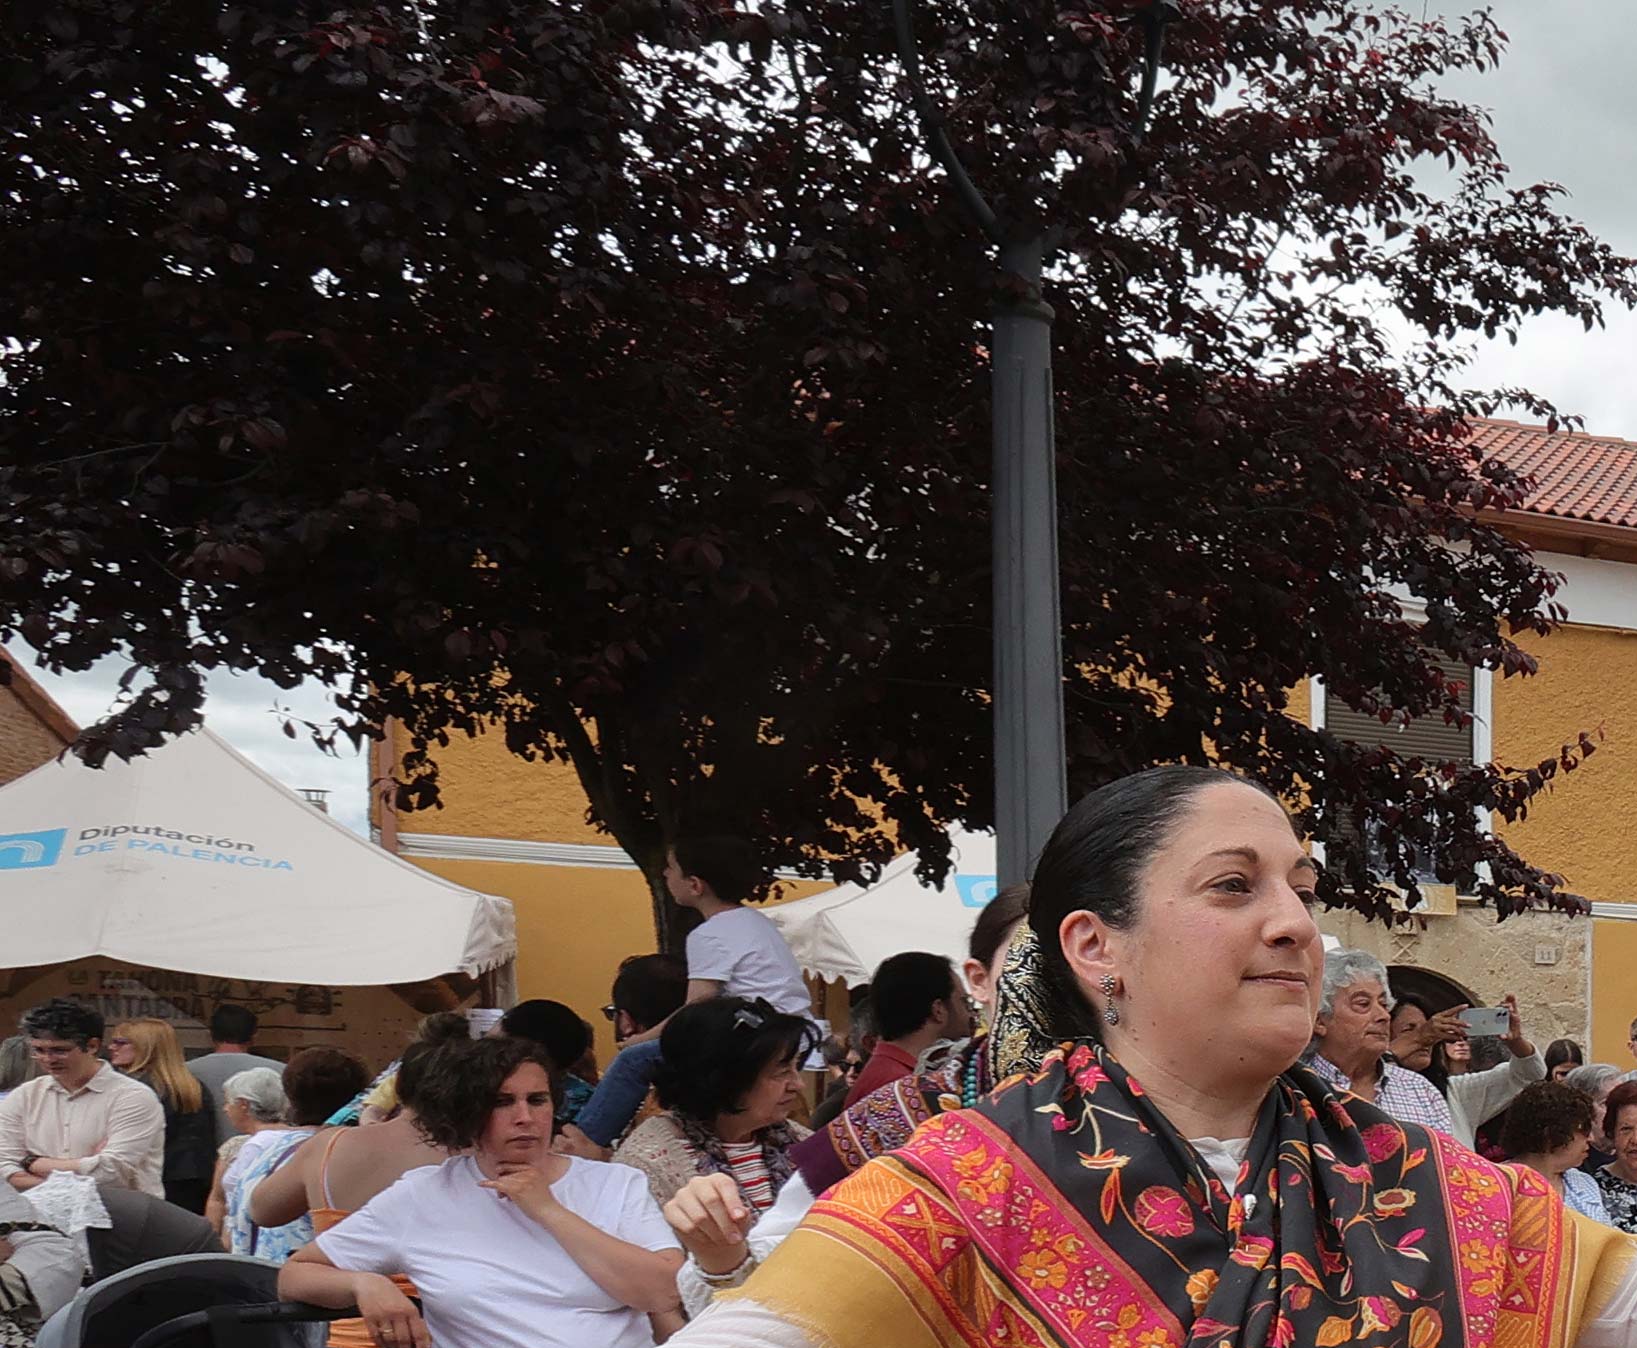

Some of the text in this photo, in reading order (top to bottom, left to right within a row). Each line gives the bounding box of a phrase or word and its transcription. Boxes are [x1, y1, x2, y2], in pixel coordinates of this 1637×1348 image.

[77, 825, 257, 853] Diputación
[73, 838, 294, 872] DE PALENCIA
